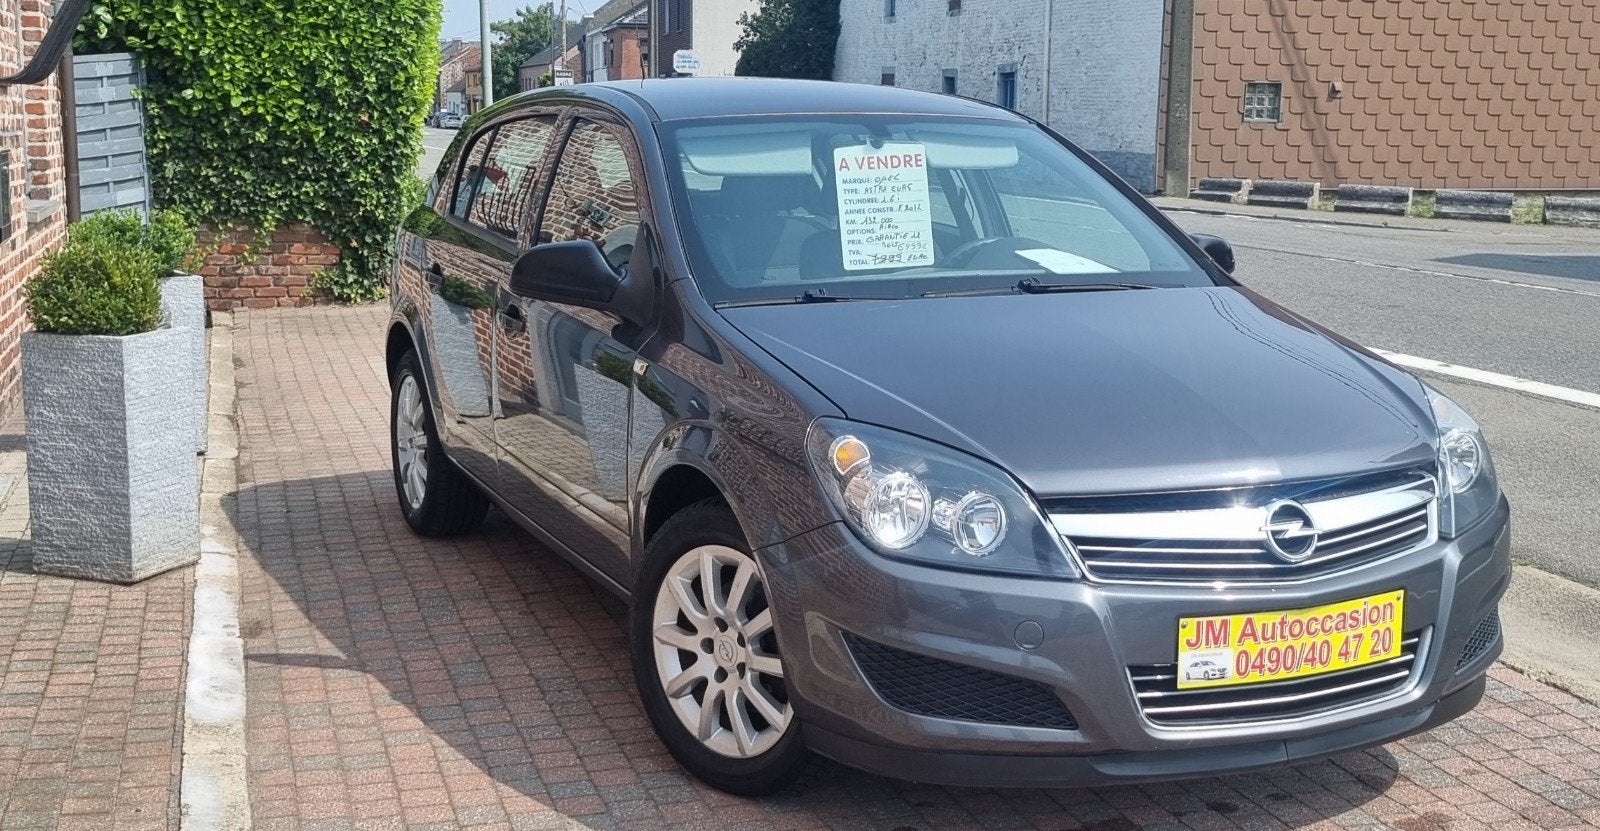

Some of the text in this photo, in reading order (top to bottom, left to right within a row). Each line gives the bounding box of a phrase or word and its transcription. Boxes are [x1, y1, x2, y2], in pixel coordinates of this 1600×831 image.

[839, 153, 923, 171] A VENDRE
[864, 184, 887, 194] ASTRA
[1185, 600, 1394, 649] JM Autoccasion
[1235, 626, 1393, 678] 0490/40 47 20
